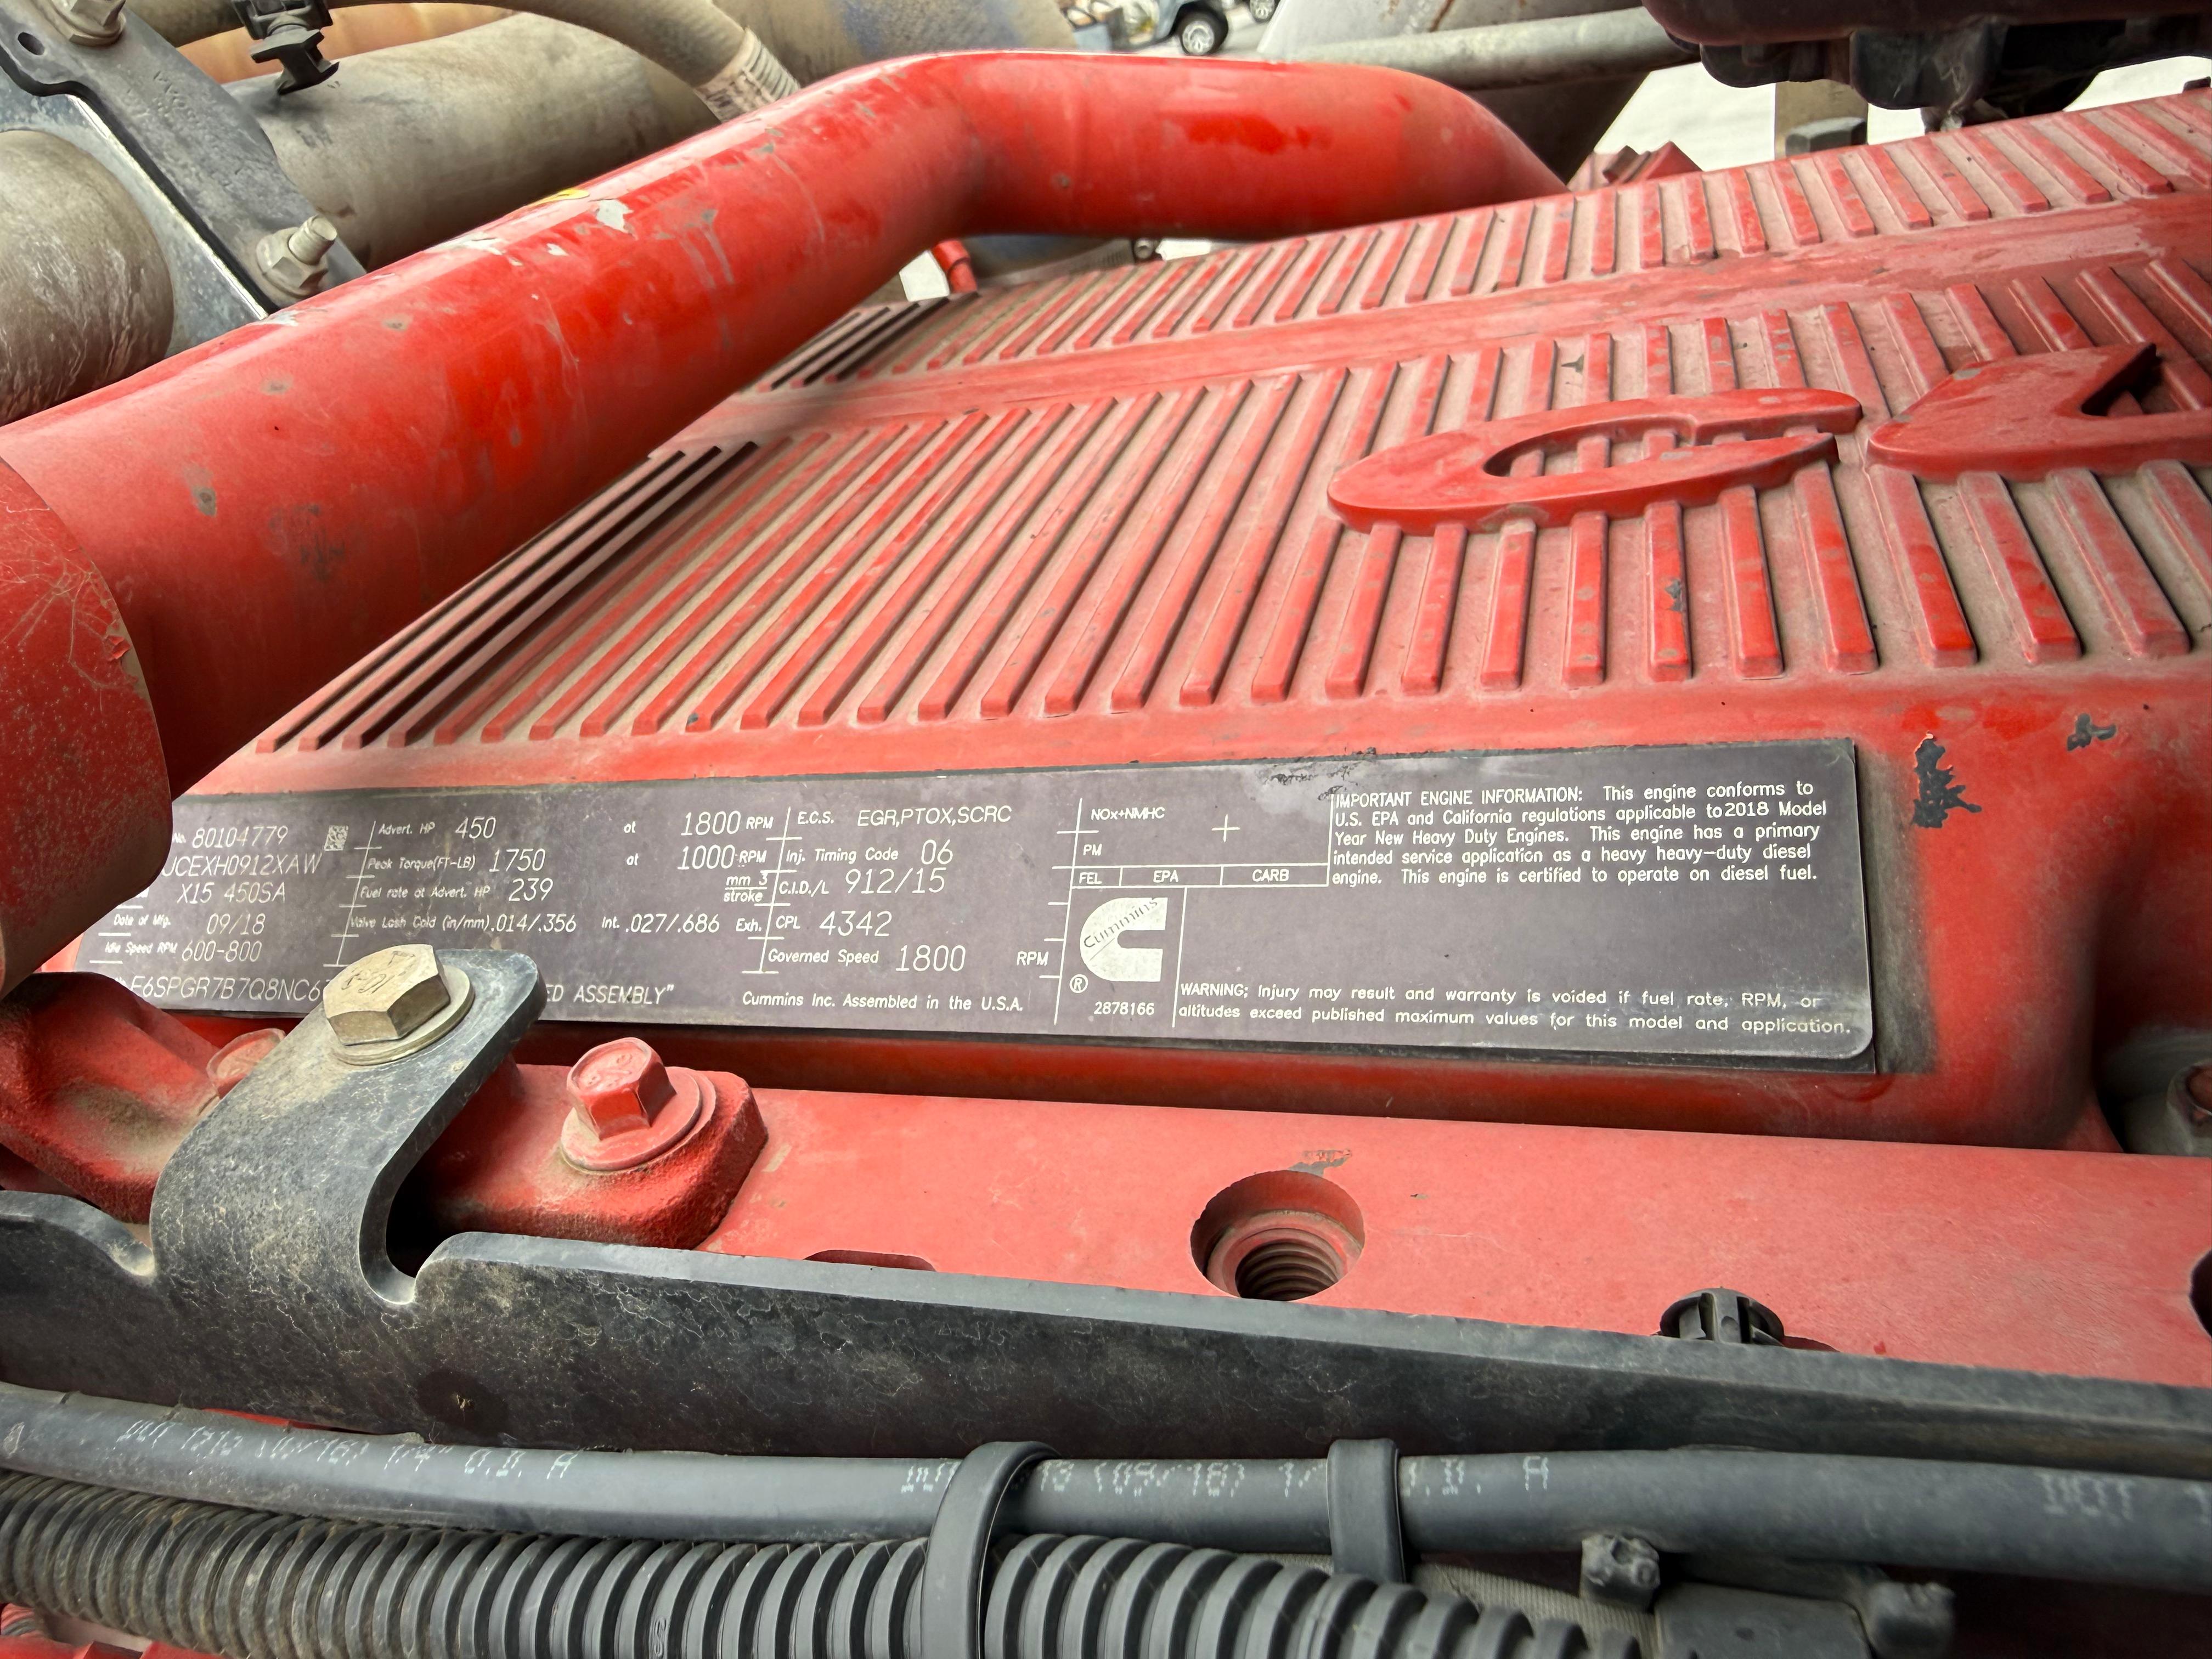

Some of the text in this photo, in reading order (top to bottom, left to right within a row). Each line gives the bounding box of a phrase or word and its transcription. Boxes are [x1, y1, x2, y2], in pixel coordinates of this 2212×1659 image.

[1336, 780, 1814, 809] IMPORTANT ENGINE INFORMATION: This engine conforms to
[680, 810, 774, 836] 1800 RPM
[797, 810, 834, 825] E.C.S.
[857, 805, 1012, 828] EGR,PTOX,SCRC
[1091, 806, 1165, 821] NOx+NMHC
[1335, 811, 1362, 827] U.S.
[1372, 810, 1399, 826] EPA
[1407, 810, 1434, 826] and
[1443, 808, 1512, 825] California
[1522, 806, 1606, 826] regulations
[1616, 804, 1696, 825] applicable
[1779, 800, 1826, 816] Model
[191, 825, 288, 849] 80104779
[378, 821, 436, 835] Advert. HP
[455, 816, 496, 839] 450
[623, 821, 636, 833] at
[1335, 821, 1820, 848] Year New Heavy Duty Engines. This engine has a primary
[489, 848, 546, 872] 1750
[626, 853, 639, 866] at
[677, 844, 767, 870] 1000 RPM
[786, 847, 899, 865] Inj. Timing Code
[921, 839, 953, 865] 06
[1083, 843, 1102, 856] PM
[1333, 849, 1393, 865] intended
[1402, 848, 1453, 864] service
[1462, 847, 1543, 867] application
[1553, 850, 1572, 862] as
[1581, 850, 1591, 862] a
[1601, 846, 1647, 865] heavy
[1762, 843, 1811, 859] diesel
[368, 857, 393, 870] Peak
[726, 876, 751, 886] mm
[845, 867, 947, 894] 912/15
[1079, 868, 1289, 884] FEL EPA CARB
[1332, 864, 1817, 888] engine. This engine is certified to operate on diesel fuel.
[177, 882, 285, 904] X15 450SA
[360, 885, 491, 898] Fuel rate at Advert. HP
[508, 877, 554, 901] 239
[723, 890, 763, 902] stroke
[113, 913, 134, 926] Date
[138, 914, 149, 926] of
[206, 912, 266, 935] 09/18
[351, 916, 376, 928] Valve
[382, 917, 407, 928] Lash
[413, 915, 437, 928] Cold
[601, 916, 620, 929] Int.
[736, 918, 762, 932] Exh.
[775, 915, 801, 929] CPL
[819, 910, 892, 936] 4342
[1083, 898, 1159, 950] Cummins
[125, 941, 154, 956] Speed
[156, 941, 178, 954] RPM
[182, 939, 262, 962] 600-800
[768, 948, 879, 967] Governed Speed
[895, 945, 966, 972] 1800
[1016, 951, 1049, 966] RPM
[742, 991, 1023, 1011] Cummins Inc. Assembled in the U.S.A.
[1258, 984, 1300, 1001] Injury
[1308, 988, 1342, 1002] may
[1351, 986, 1396, 1000] result
[1405, 987, 1435, 1001] and
[1446, 988, 1517, 1005] warranty
[1527, 988, 1541, 1002] is
[1552, 989, 1607, 1004] voided
[1618, 990, 1630, 1004] if
[1641, 990, 1674, 1006] fuel
[1800, 997, 1822, 1008] or
[1093, 1001, 1155, 1016] 2878166
[1178, 1003, 1850, 1035] altitudes exceed published maximum values for this model and application.
